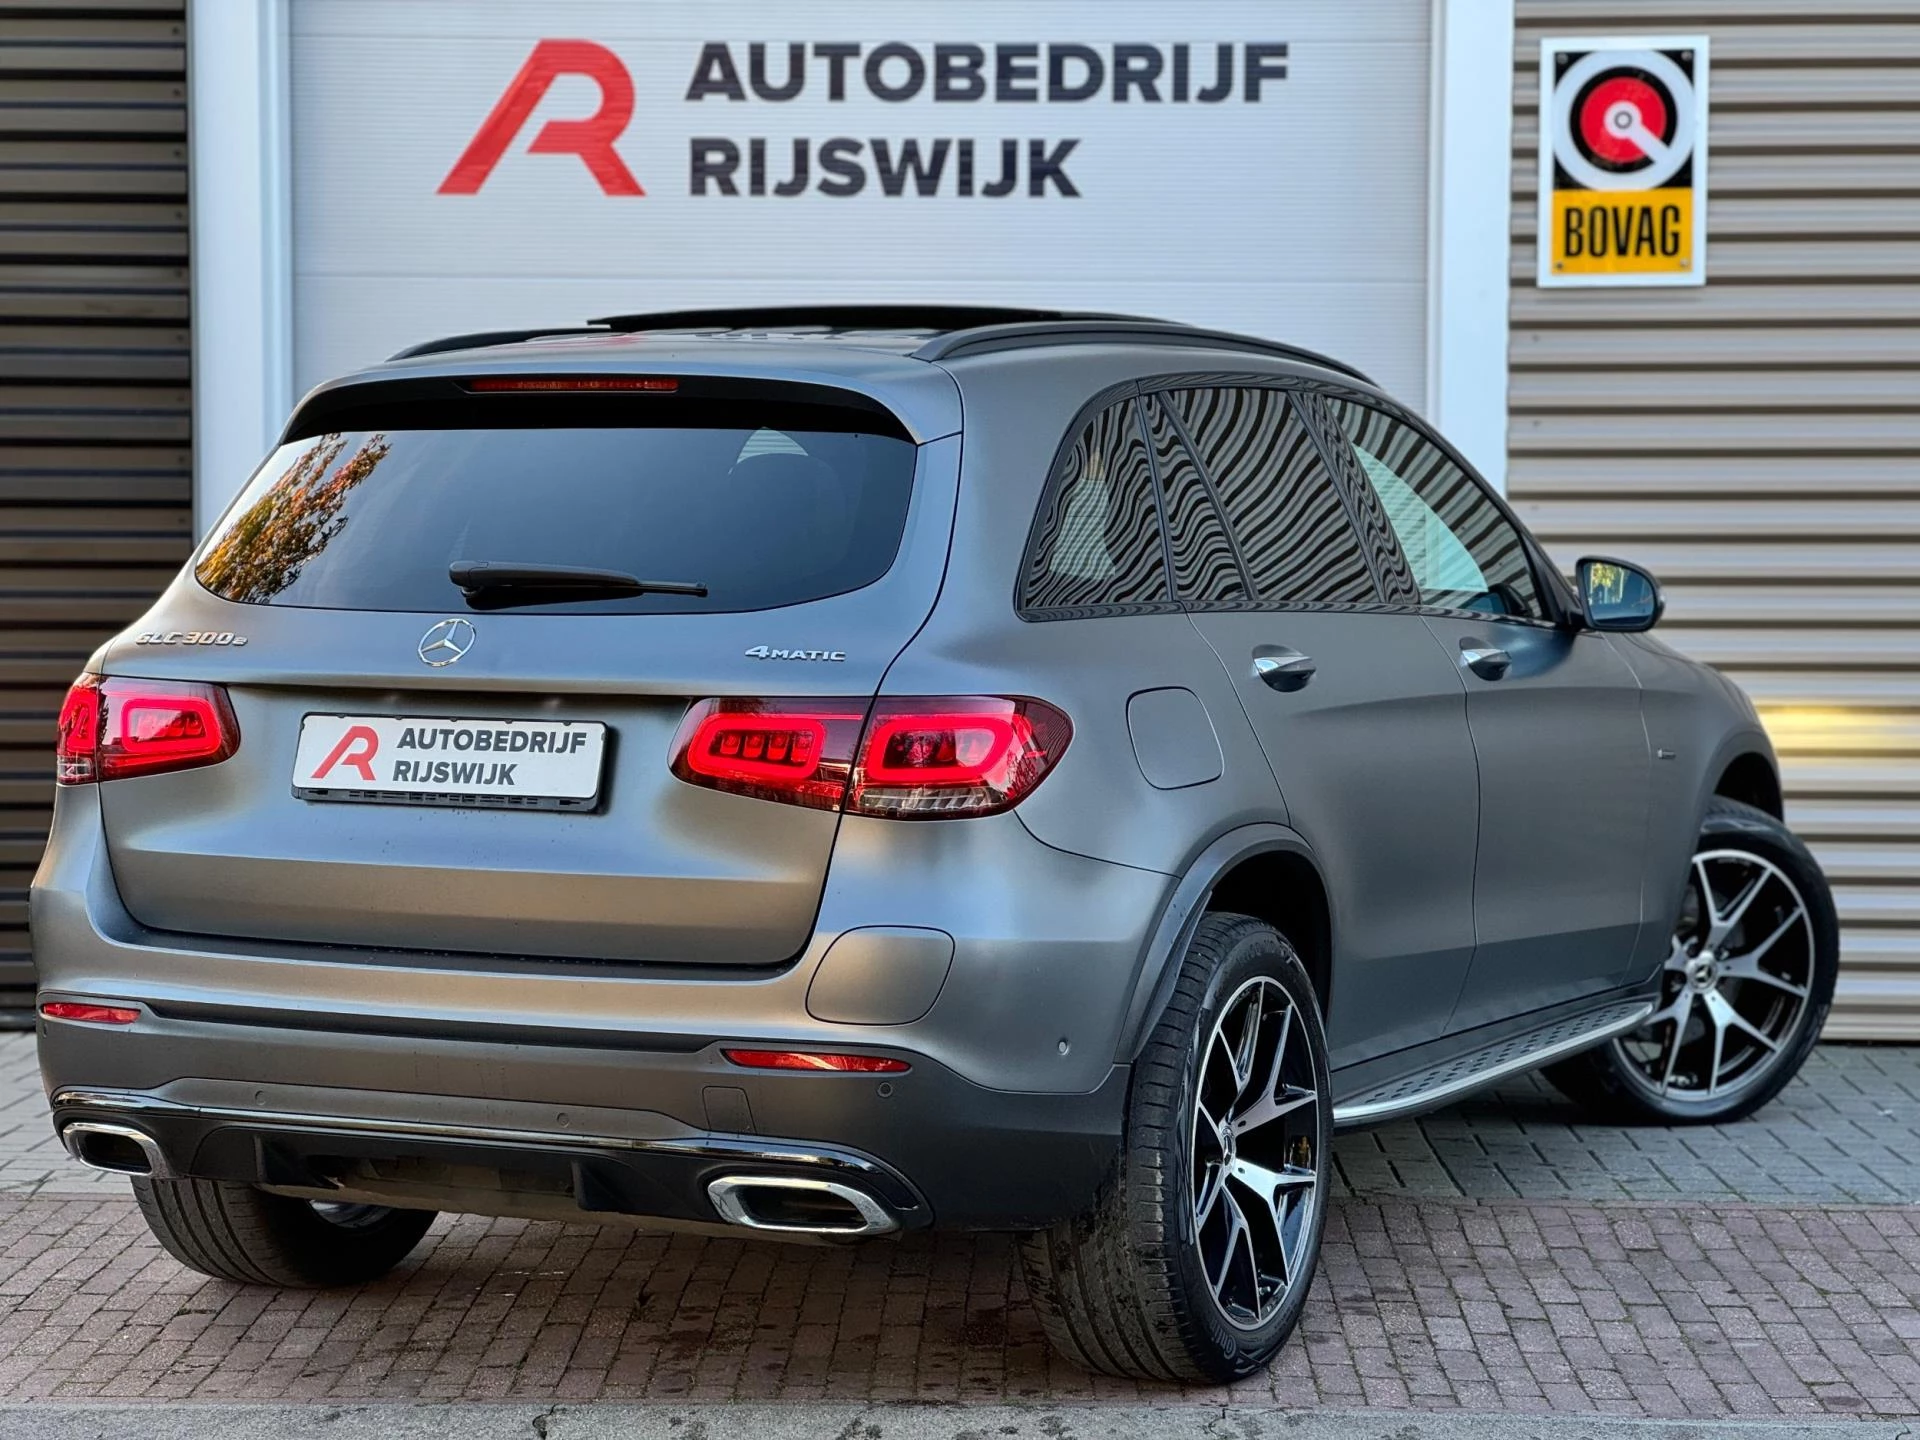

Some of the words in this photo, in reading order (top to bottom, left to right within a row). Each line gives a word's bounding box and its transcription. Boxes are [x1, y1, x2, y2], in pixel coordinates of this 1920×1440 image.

[685, 42, 1289, 103] AUTOBEDRIJF
[689, 138, 1082, 197] RIJSWIJK
[1564, 205, 1680, 257] BOVAG
[136, 632, 182, 645] GLC
[745, 645, 846, 661] 4MATIC
[396, 728, 587, 754] AUTOBEDRIJF
[392, 760, 517, 786] RIJSWIJK
